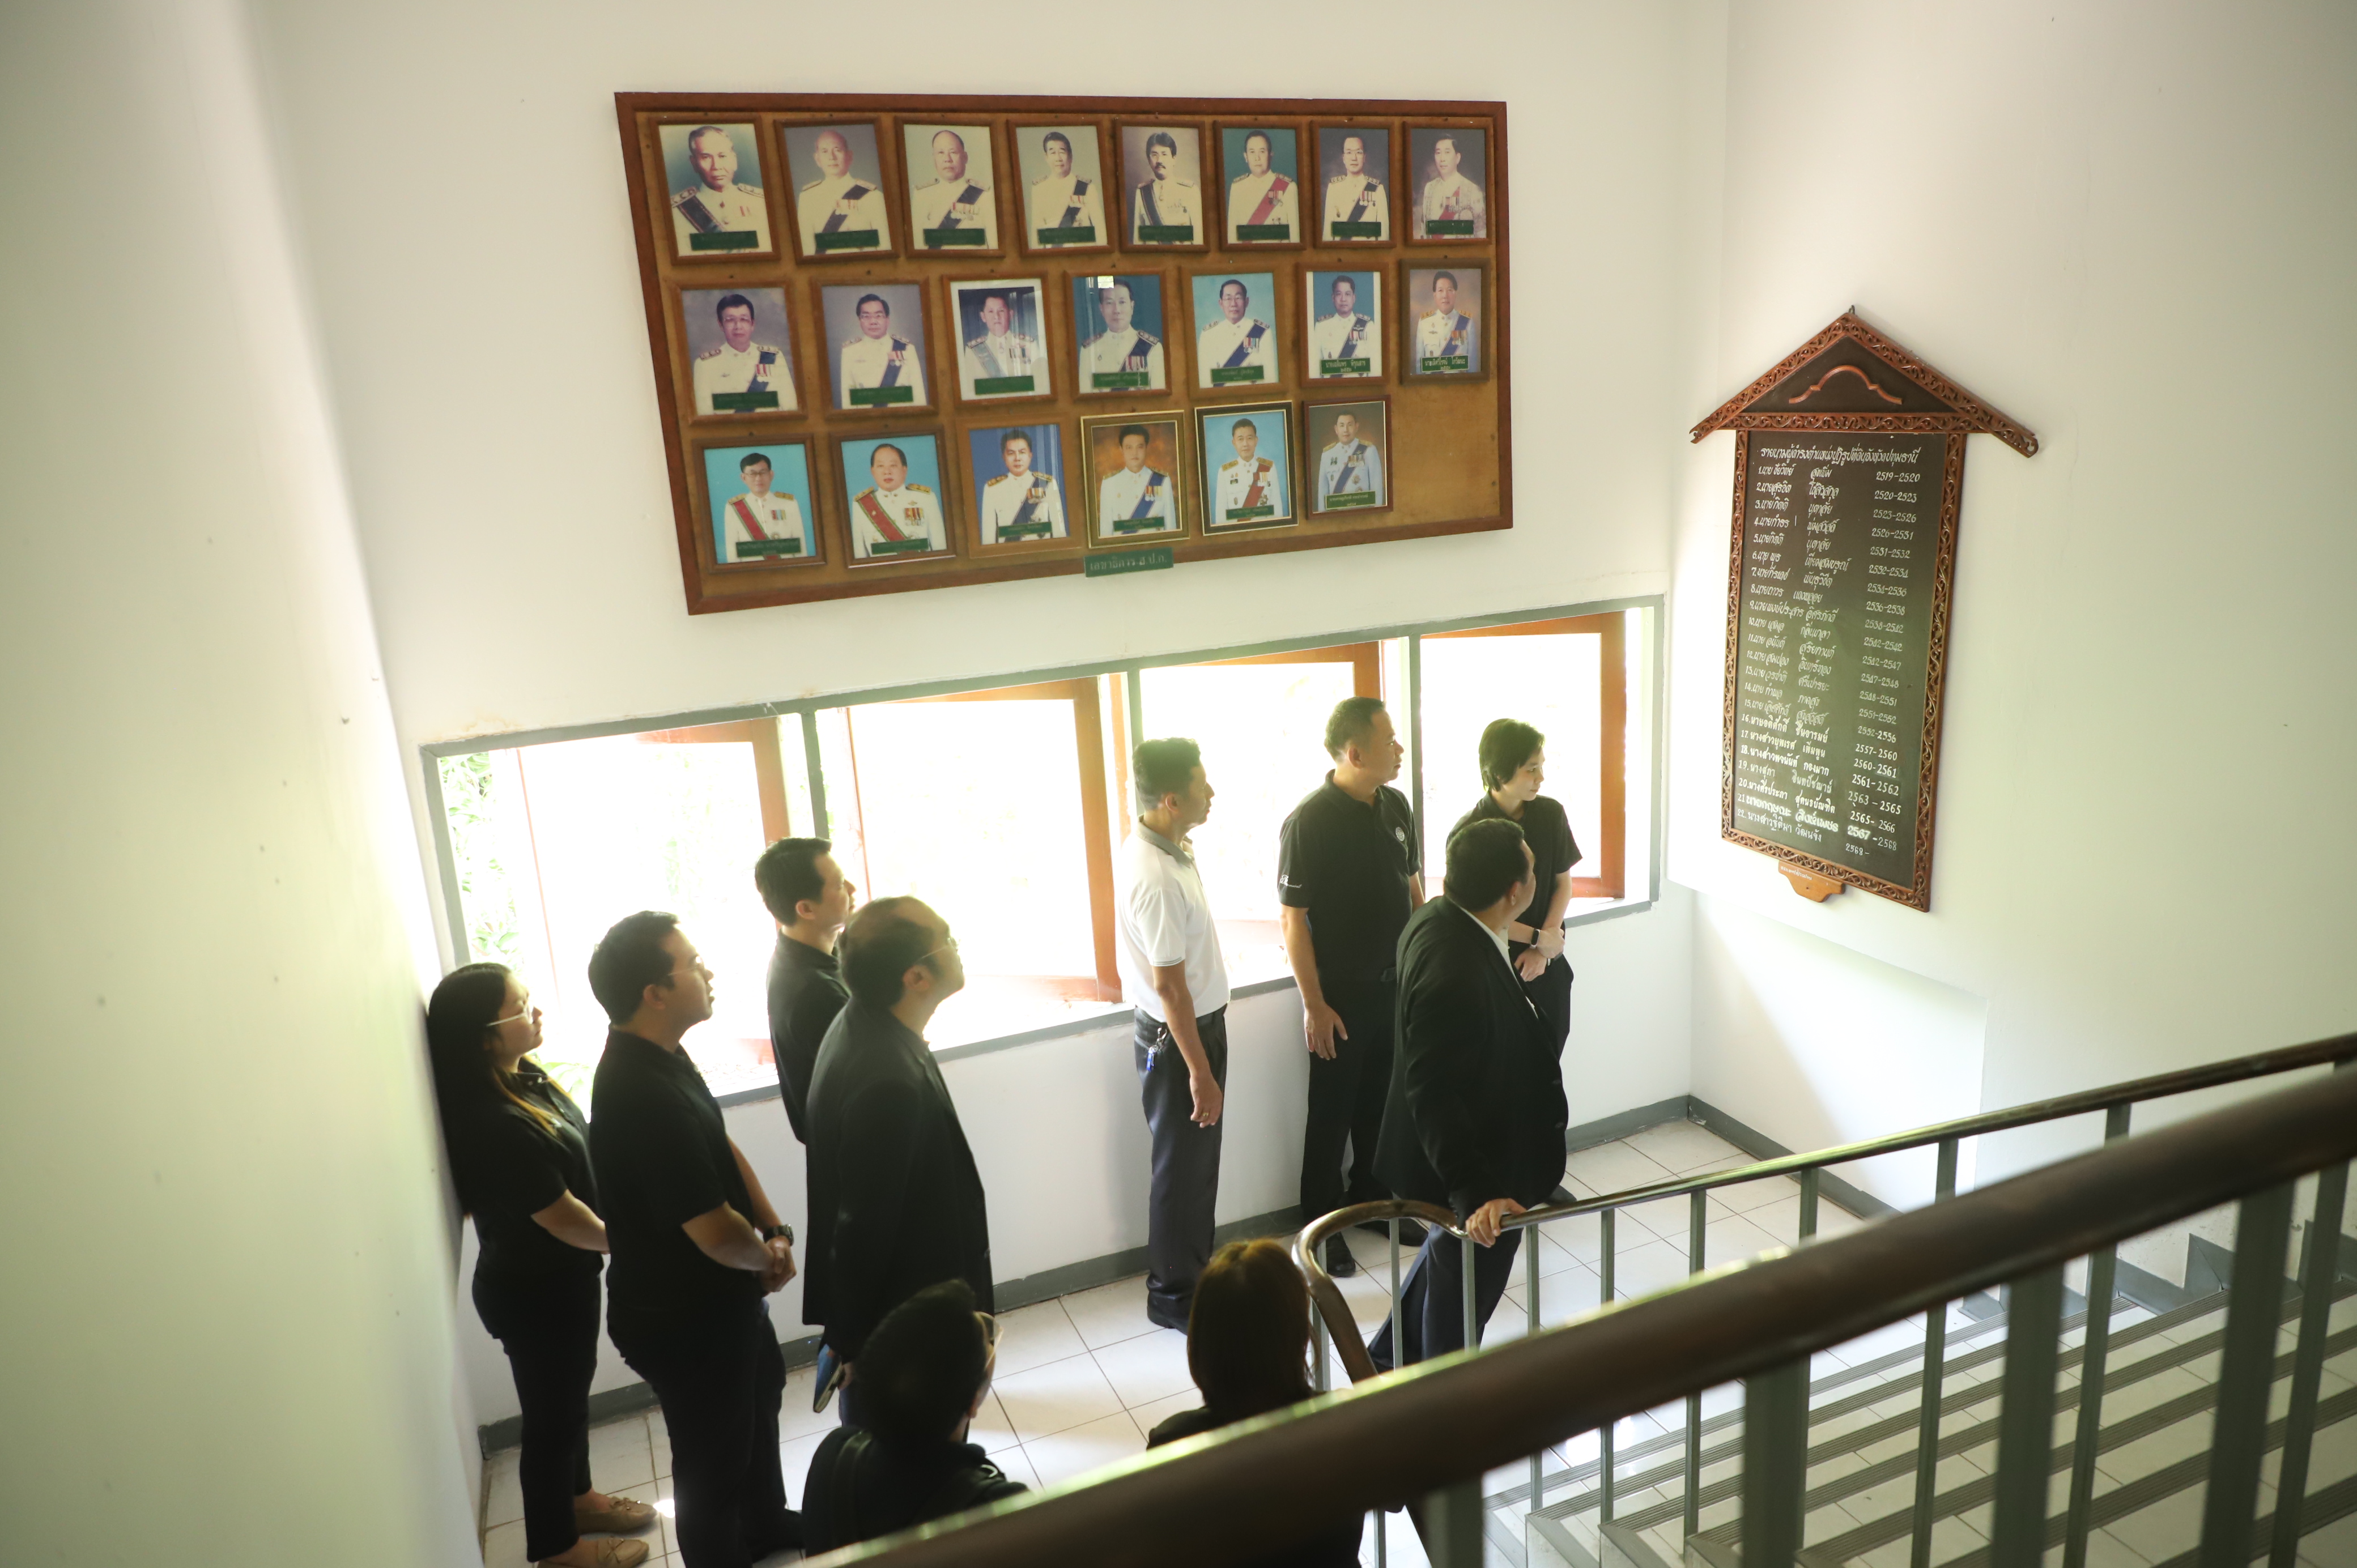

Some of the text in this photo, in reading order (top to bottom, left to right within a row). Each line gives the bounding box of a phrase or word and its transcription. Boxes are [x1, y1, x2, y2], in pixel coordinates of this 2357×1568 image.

[1876, 471, 1920, 483] 2519-2520
[1874, 490, 1917, 503] 2520-2523
[1873, 509, 1916, 523] 2523-2526
[1871, 527, 1914, 540] 2526-2531
[1870, 547, 1911, 559] 2531-2532
[1869, 565, 1909, 578] 2532-2534
[1867, 583, 1907, 596] 2534-2536
[1866, 601, 1905, 616] 2536-2538
[1865, 620, 1904, 633] 2538-2542
[1864, 637, 1903, 652] 2542-2542
[1862, 655, 1901, 671] 2542-2547
[1861, 673, 1899, 688] 2547-2548
[1859, 691, 1897, 706] 2548-2551
[1858, 708, 1897, 725] 2551-2552
[1857, 726, 1896, 743] 2552-2556
